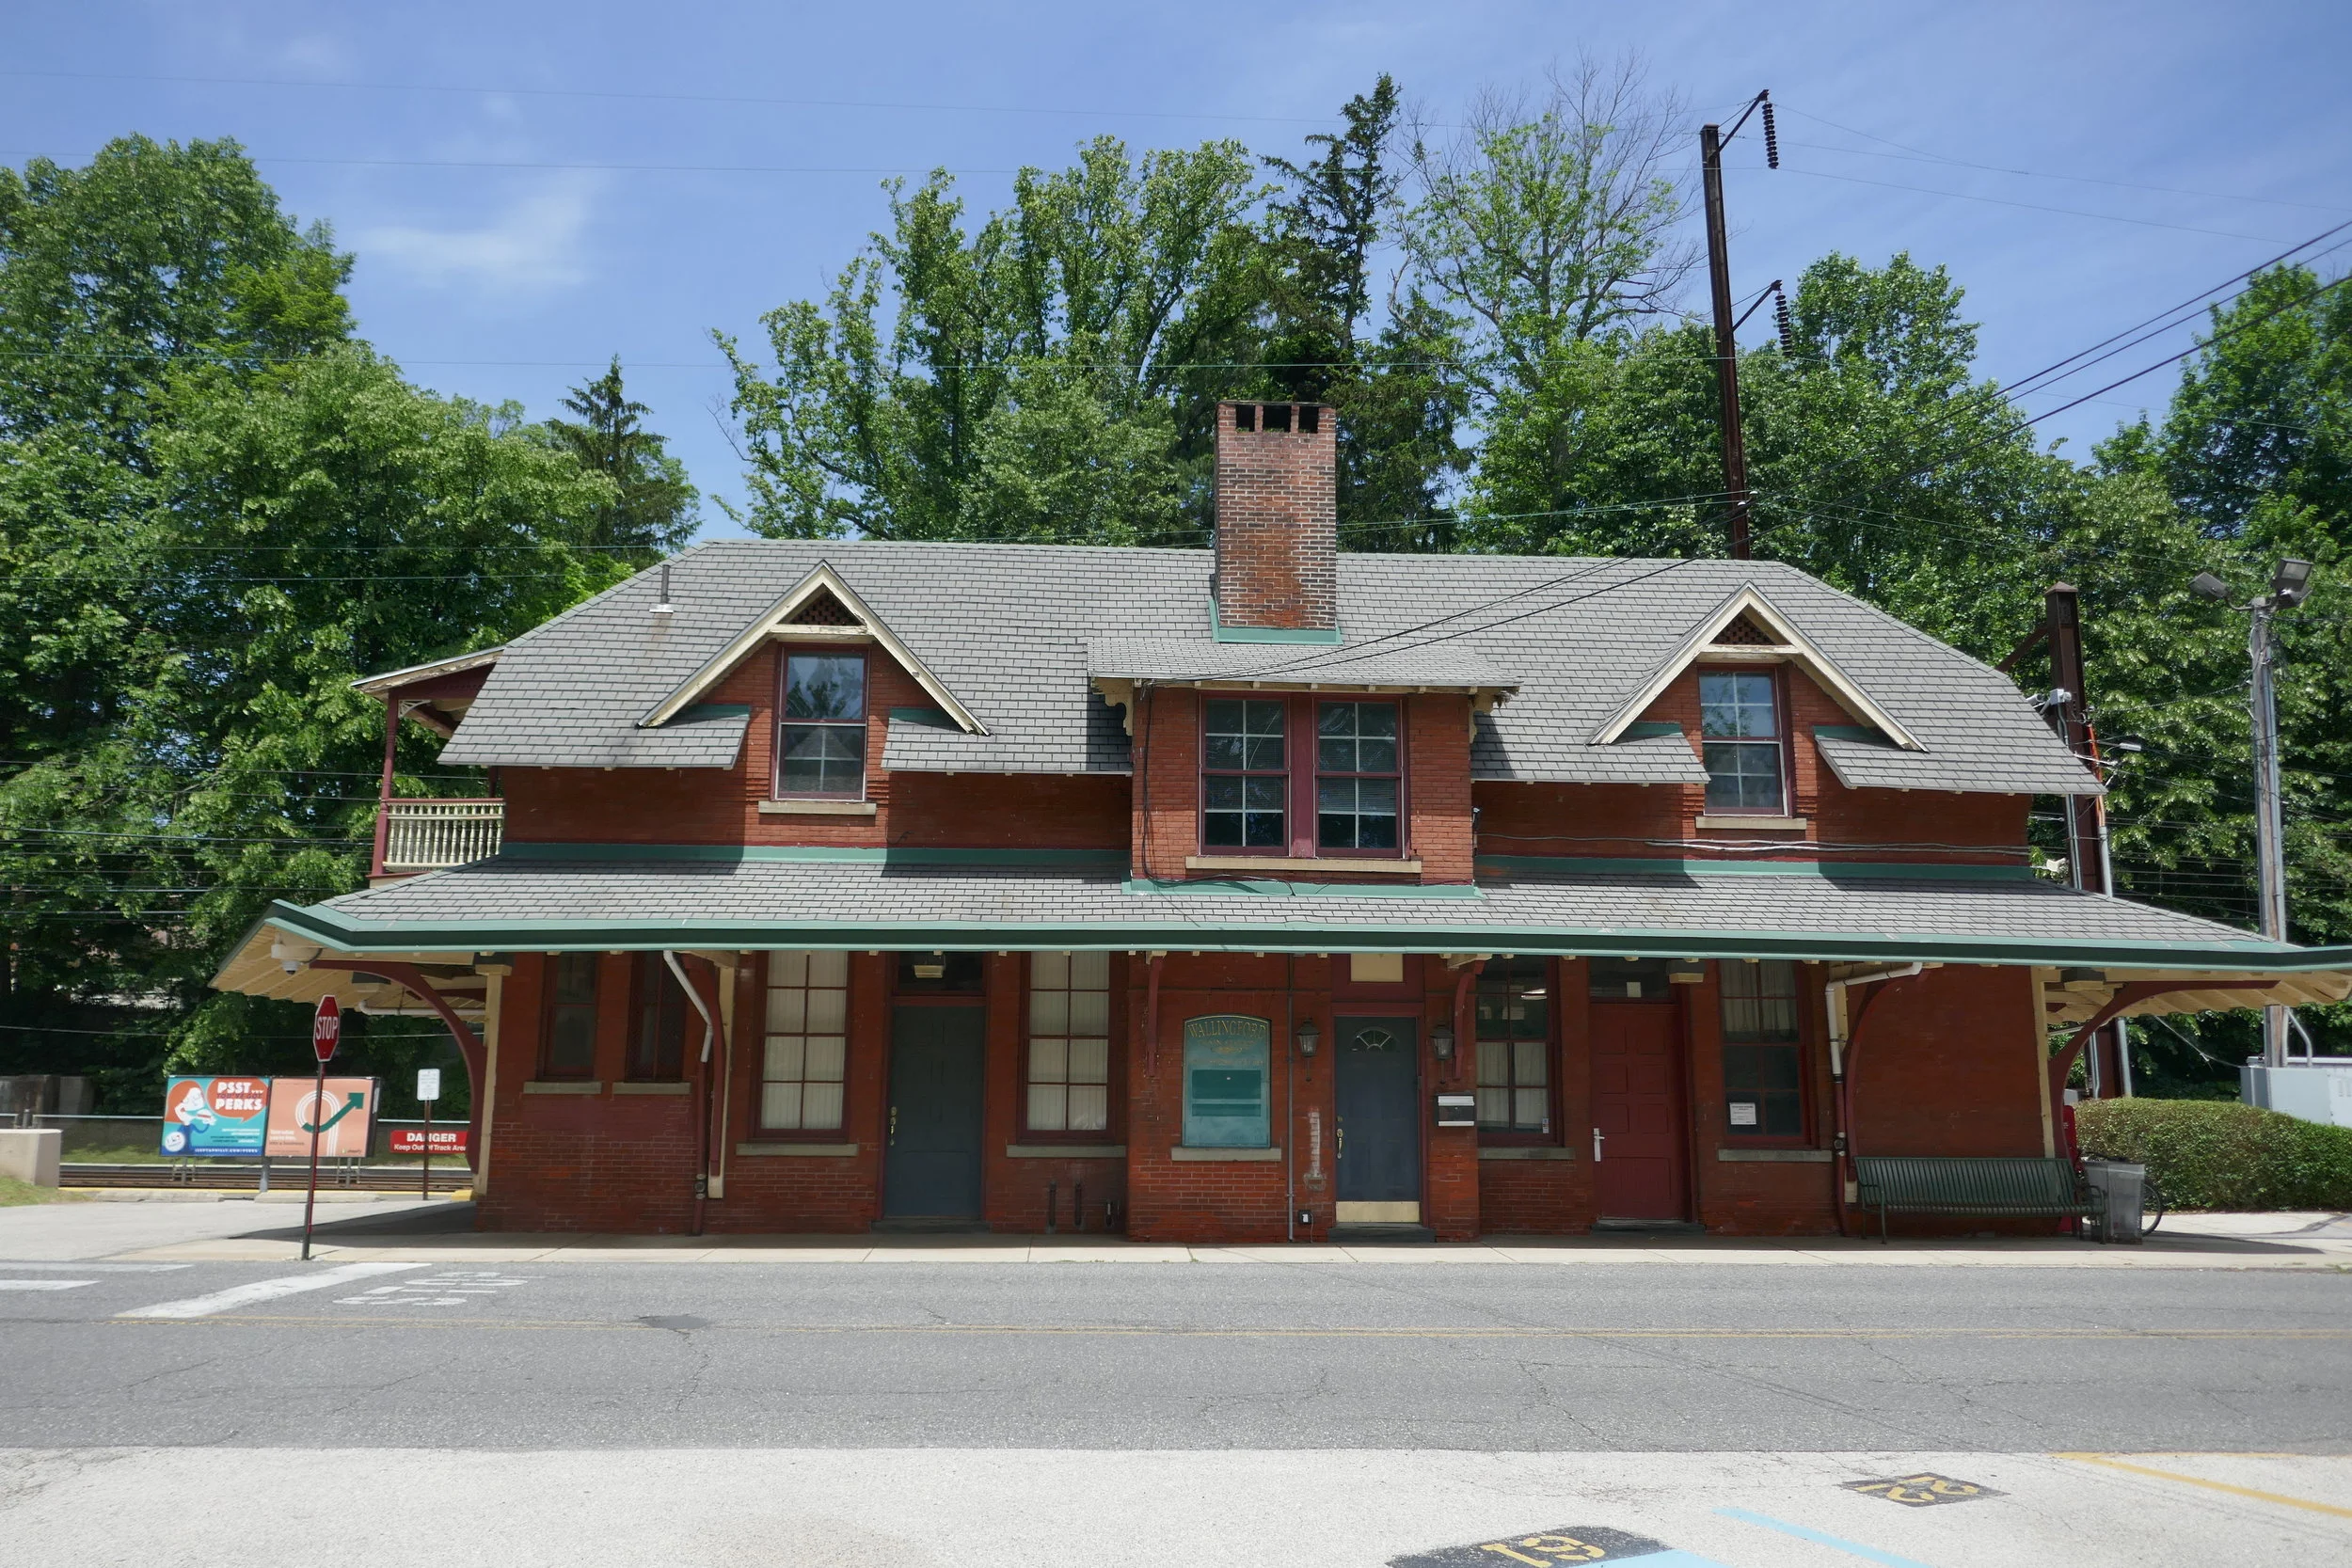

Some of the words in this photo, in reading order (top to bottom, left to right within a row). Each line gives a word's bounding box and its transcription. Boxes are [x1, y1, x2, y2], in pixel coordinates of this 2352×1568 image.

[315, 1016, 339, 1040] STOP
[1187, 1020, 1266, 1038] WALLINGFORD
[215, 1099, 262, 1110] PERKS
[332, 1271, 547, 1306] STOP
